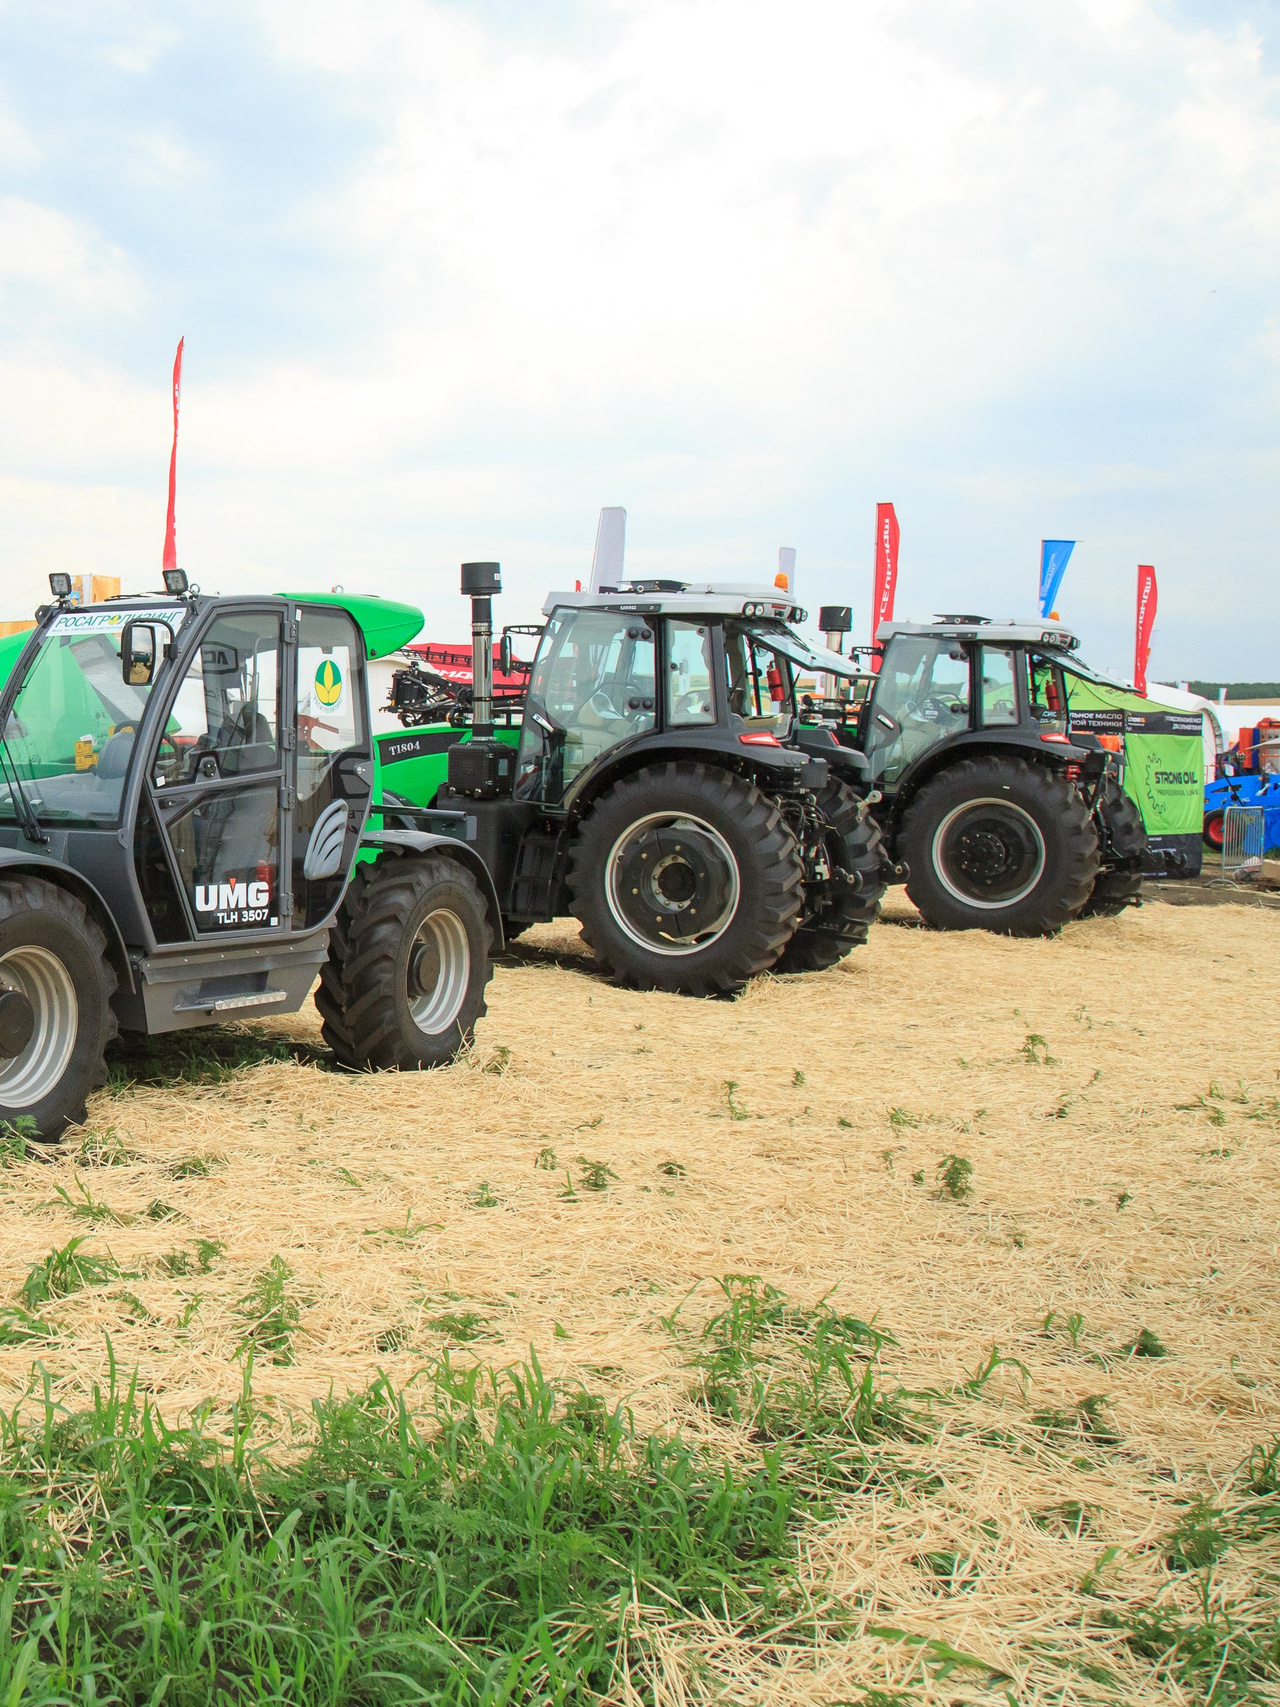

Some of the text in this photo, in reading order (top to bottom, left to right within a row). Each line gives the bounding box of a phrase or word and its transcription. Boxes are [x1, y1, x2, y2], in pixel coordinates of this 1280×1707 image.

[388, 741, 421, 756] T1804
[1155, 771, 1198, 784] STRONG OIL
[195, 881, 270, 912] UMG
[216, 909, 269, 924] TLH 3507
